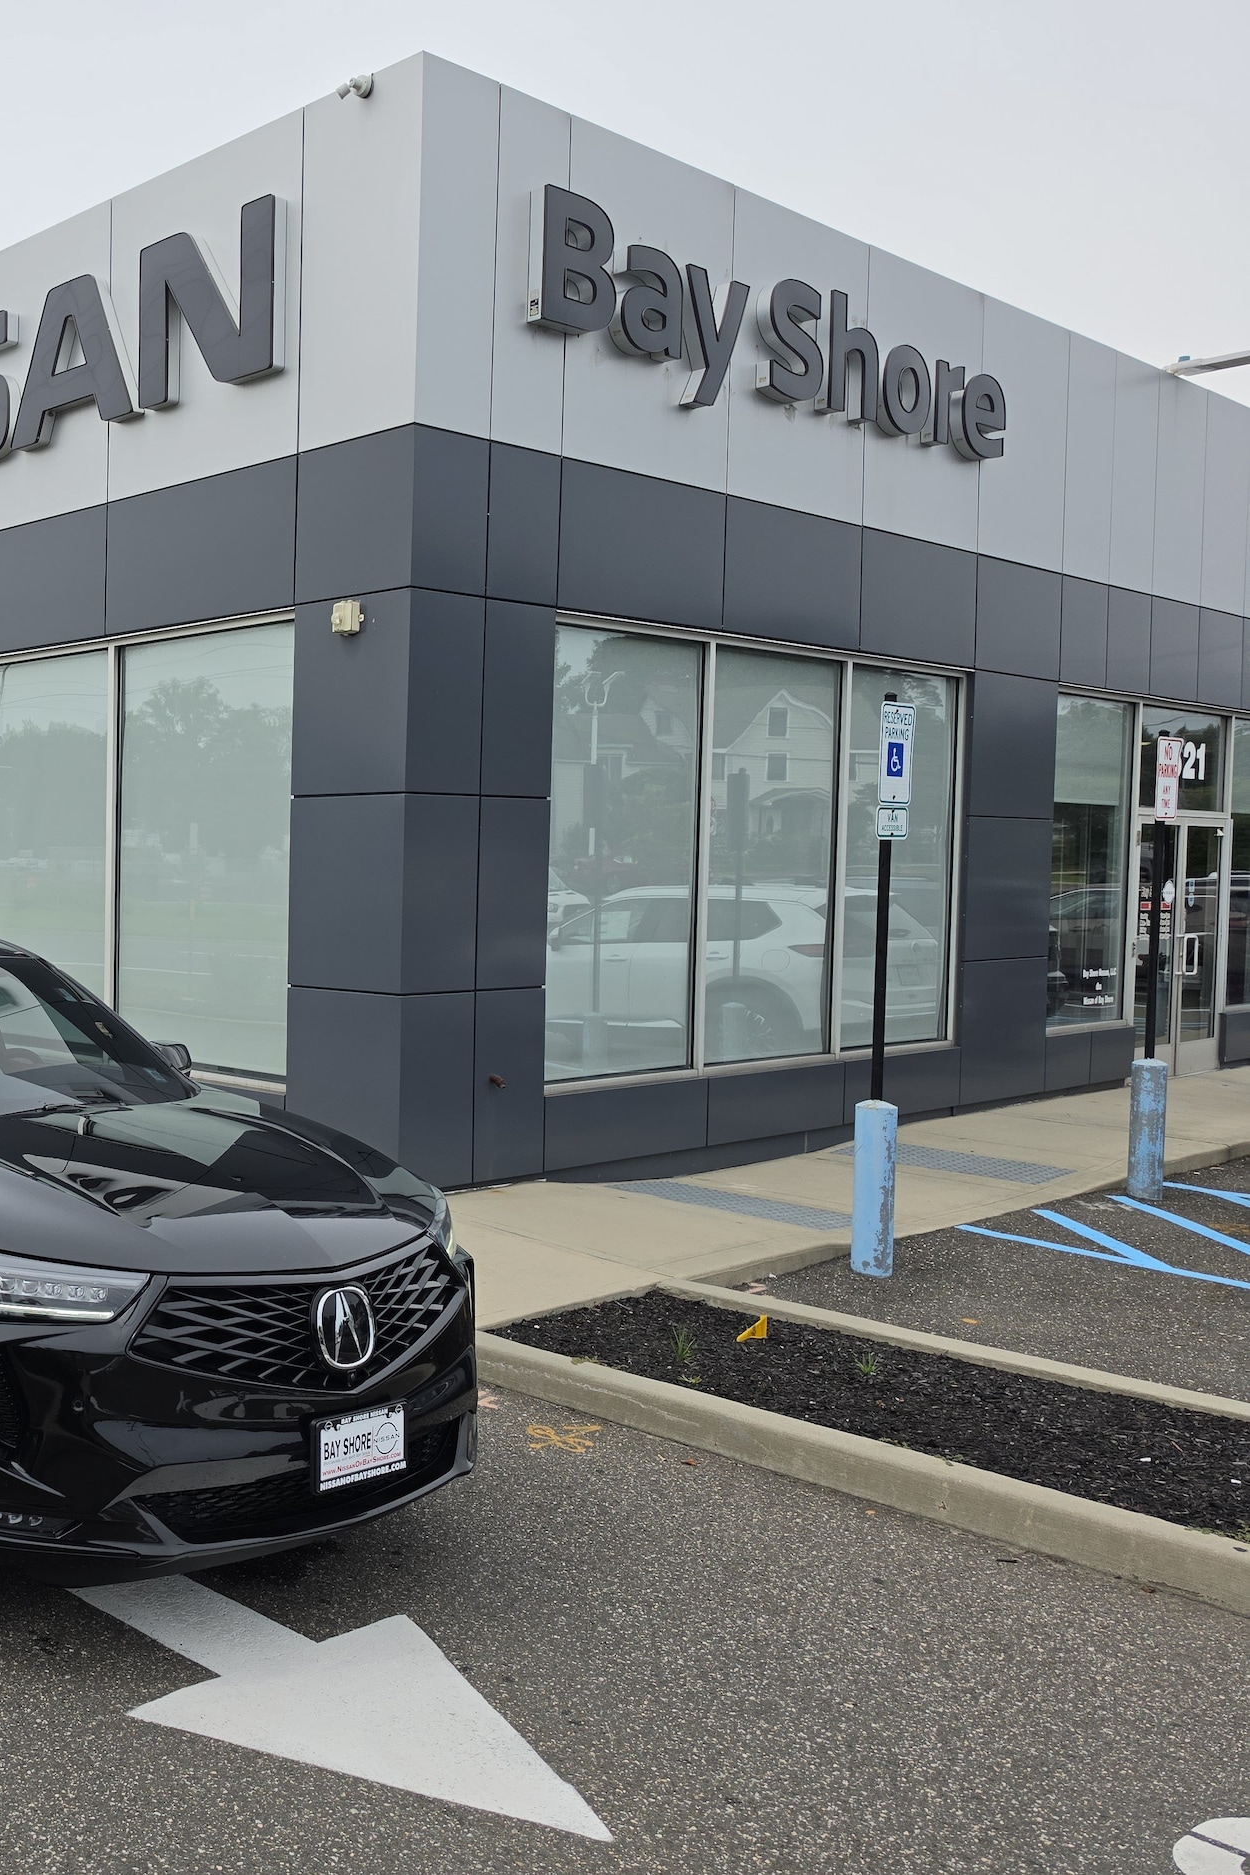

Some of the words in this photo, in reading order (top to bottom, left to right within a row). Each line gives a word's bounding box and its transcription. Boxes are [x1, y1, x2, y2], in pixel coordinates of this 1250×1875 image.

[528, 184, 750, 408] Bay
[756, 279, 1006, 461] Shore
[884, 711, 912, 726] RESERVED
[885, 726, 910, 741] PARKING
[1163, 745, 1173, 761] NO
[1178, 741, 1206, 780] 21
[1158, 764, 1178, 778] PARKING
[1162, 785, 1171, 795] ANY
[887, 813, 899, 823] VAN
[340, 1415, 352, 1425] BAY
[373, 1432, 400, 1444] NISSAN
[324, 1439, 341, 1460] BAY
[343, 1432, 371, 1456] SHORE
[320, 1460, 407, 1491] NISSANOFBAYSHORE.COM
